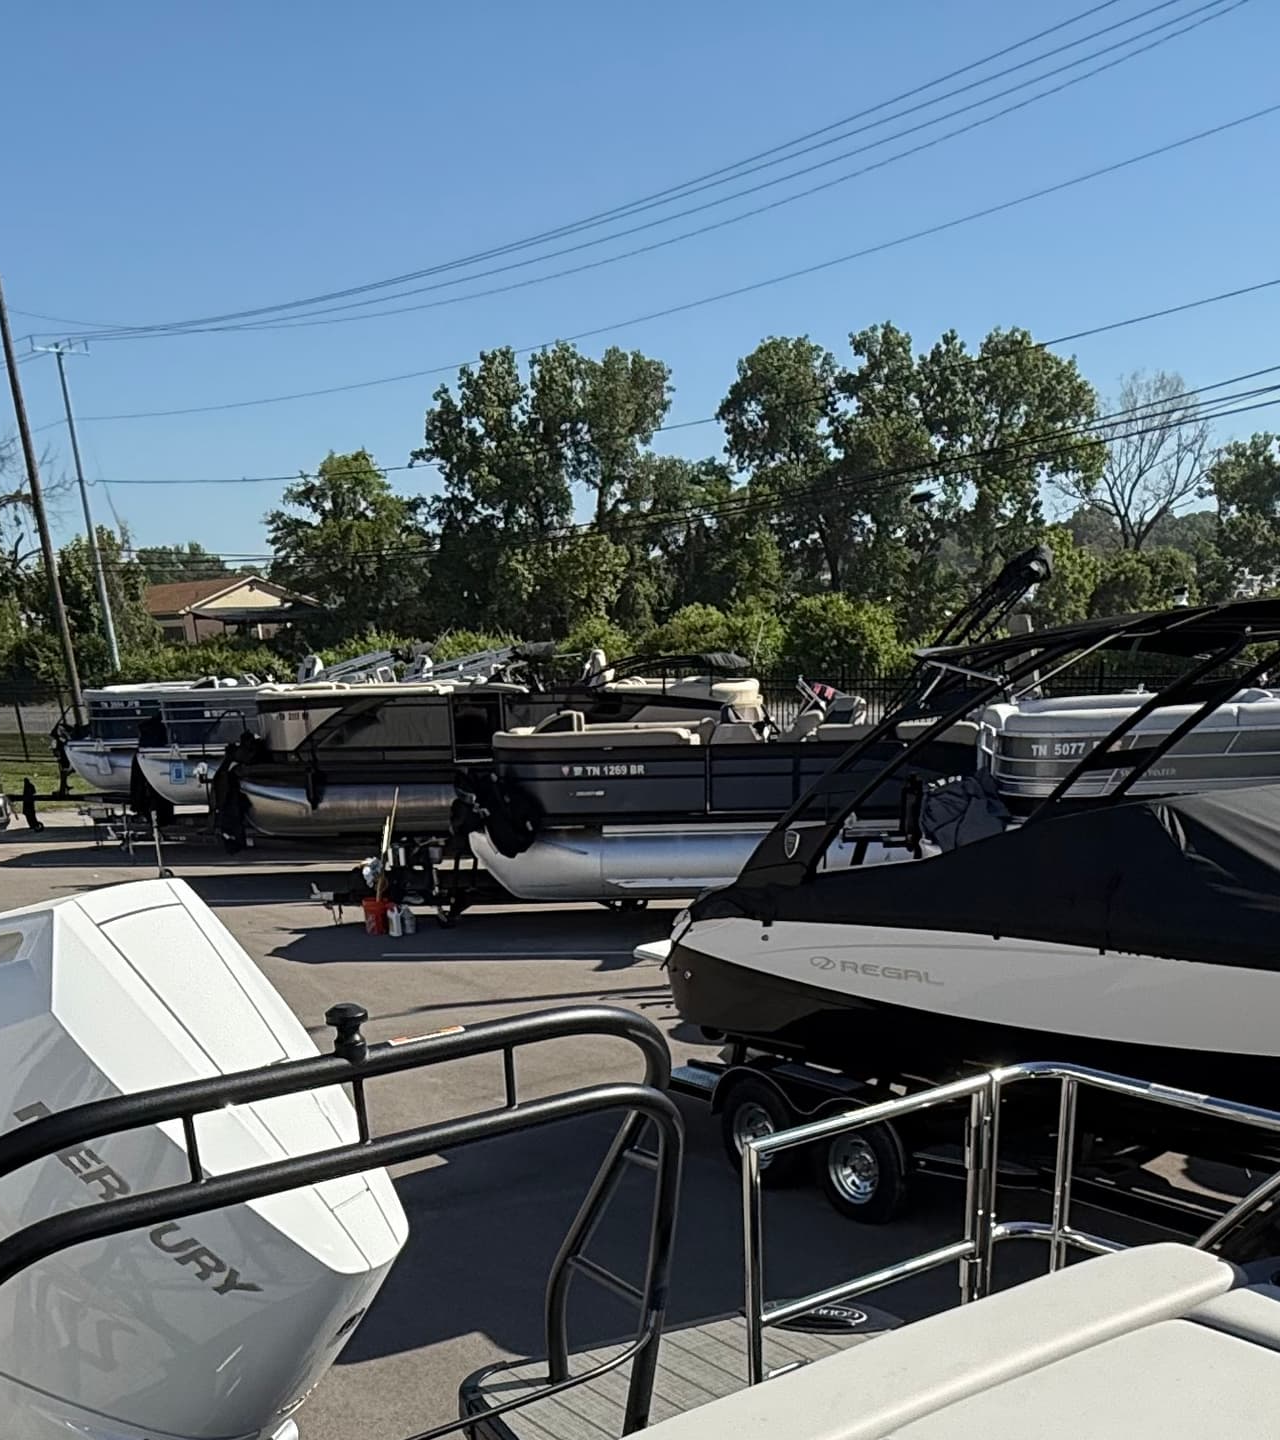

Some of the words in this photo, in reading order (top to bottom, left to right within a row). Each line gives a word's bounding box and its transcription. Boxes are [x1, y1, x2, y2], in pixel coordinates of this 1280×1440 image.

[1031, 744, 1048, 757] TN
[1054, 742, 1086, 756] 5077
[585, 766, 601, 776] TN
[840, 960, 945, 986] REGAL
[13, 1101, 265, 1296] ERURY
